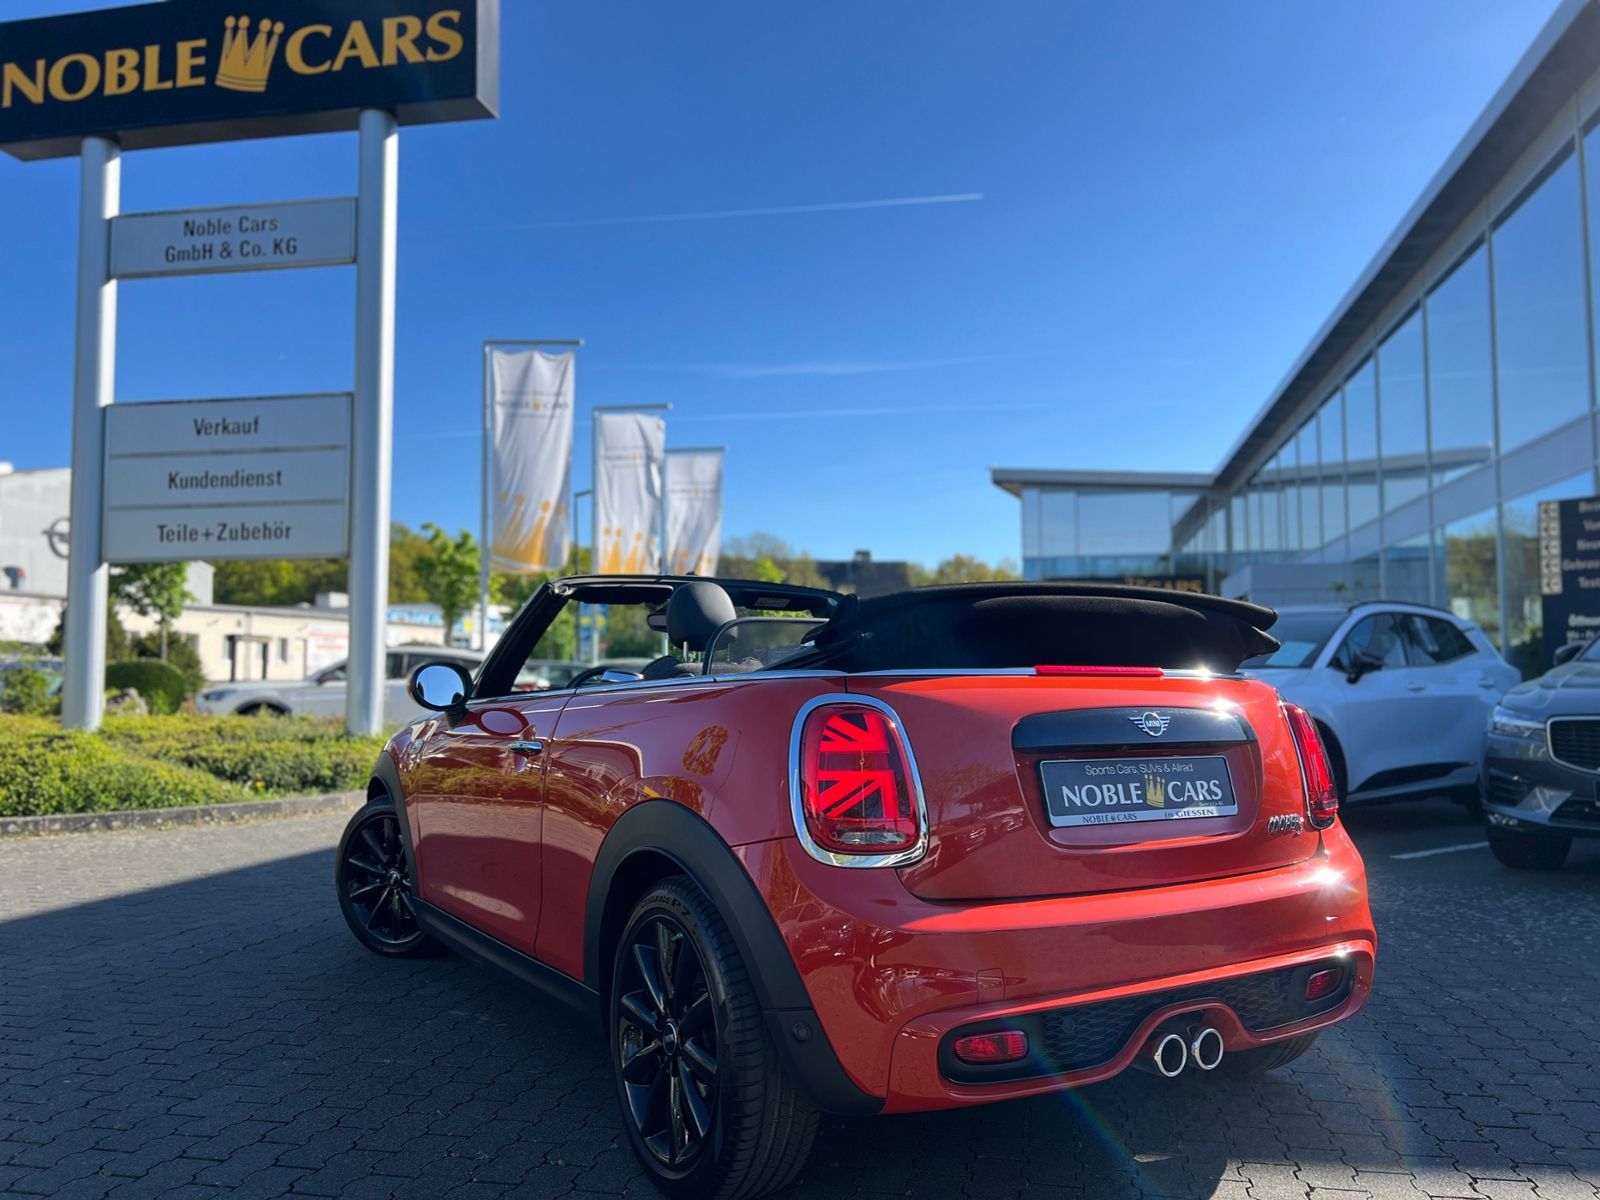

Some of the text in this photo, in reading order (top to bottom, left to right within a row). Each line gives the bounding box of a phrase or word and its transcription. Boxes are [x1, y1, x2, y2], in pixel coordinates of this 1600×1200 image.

[1, 10, 464, 108] NOBLE CARS
[183, 215, 279, 238] Noble Cars
[164, 237, 298, 264] GmbH & Co. KG
[193, 415, 260, 437] Verkauf
[168, 469, 283, 490] Kundendienst
[1085, 765, 1115, 777] Sports
[1140, 763, 1162, 774] SUVs
[1163, 763, 1170, 773] &
[1061, 779, 1223, 807] NOBLE CARS
[1082, 812, 1138, 824] NOBLE CARS
[1175, 808, 1214, 818] GIESSEN
